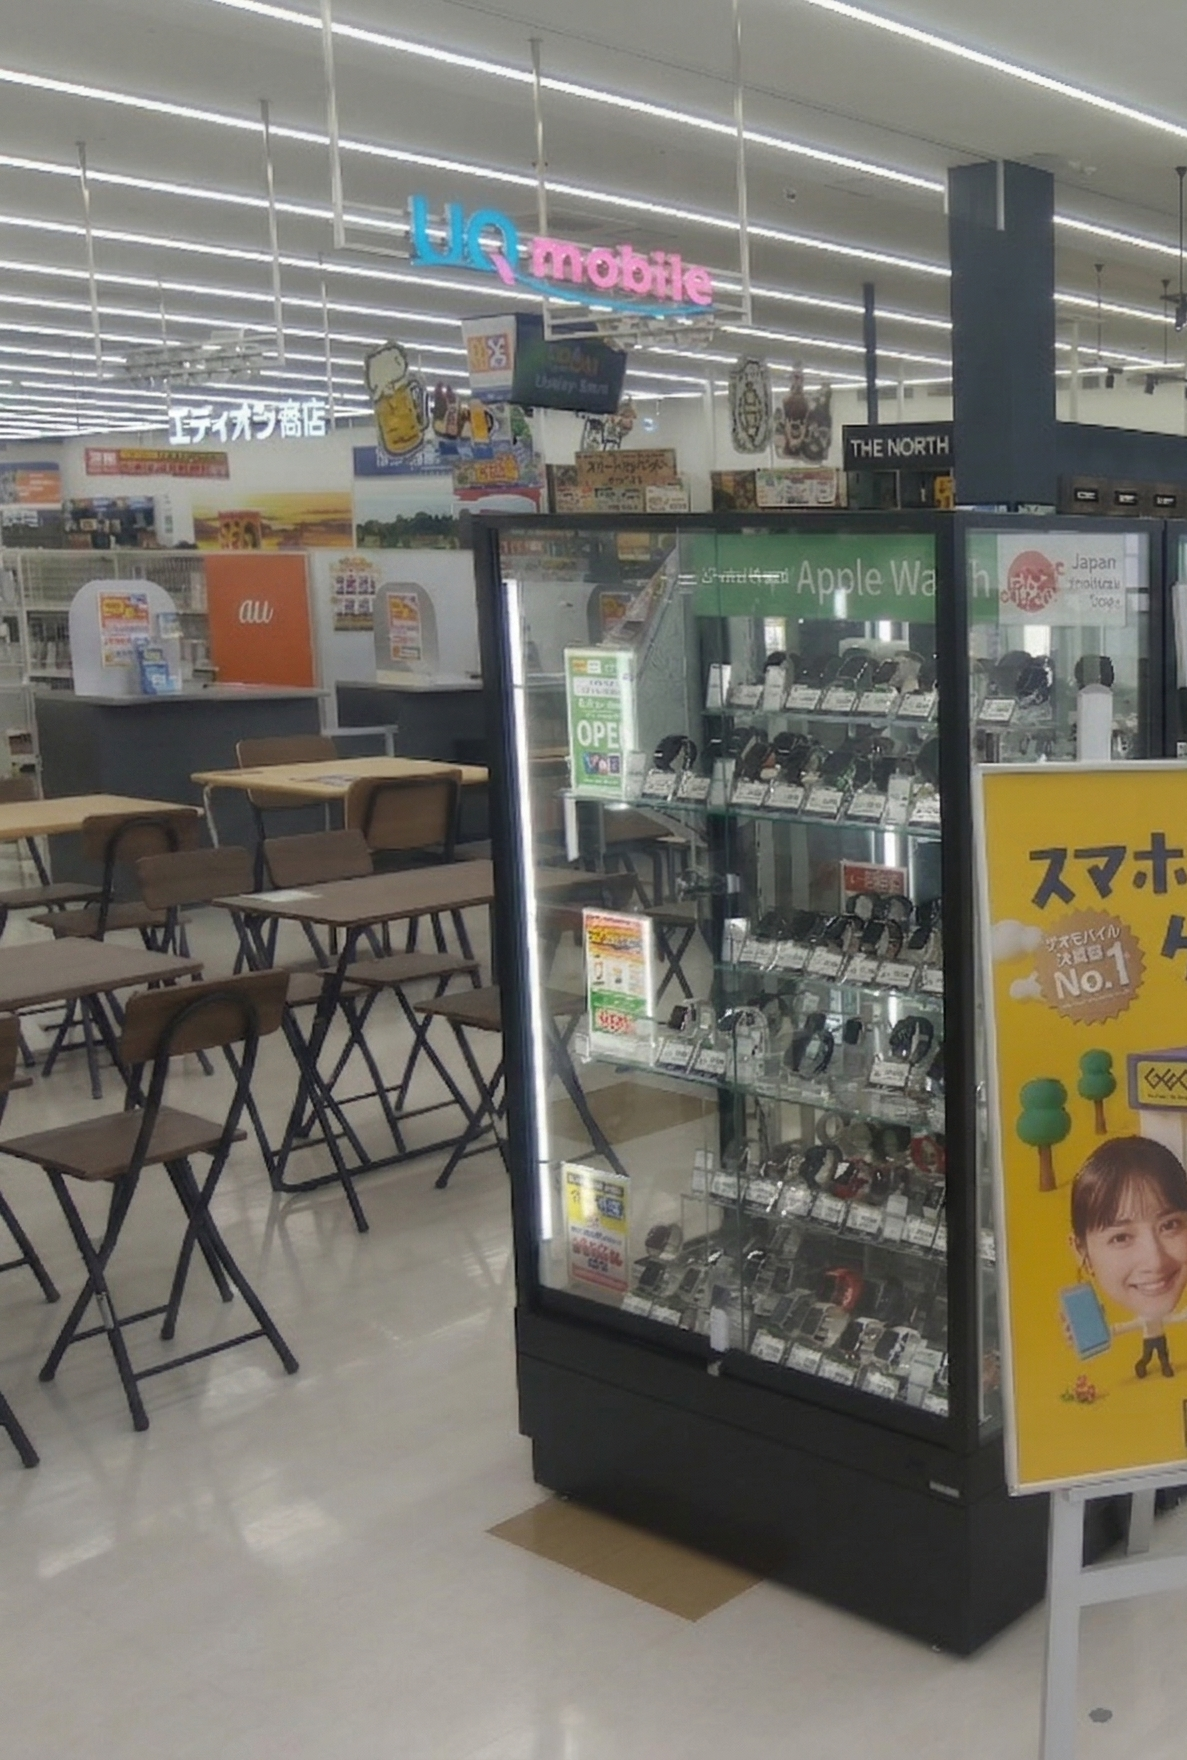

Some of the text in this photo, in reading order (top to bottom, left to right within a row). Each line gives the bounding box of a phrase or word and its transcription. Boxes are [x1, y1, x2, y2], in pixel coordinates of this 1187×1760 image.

[409, 195, 713, 306] UQ mobile
[850, 435, 949, 458] THE NORTH
[1071, 552, 1116, 574] Japan
[797, 558, 884, 605] Apple
[239, 600, 273, 624] au
[1054, 941, 1130, 999] No.1
